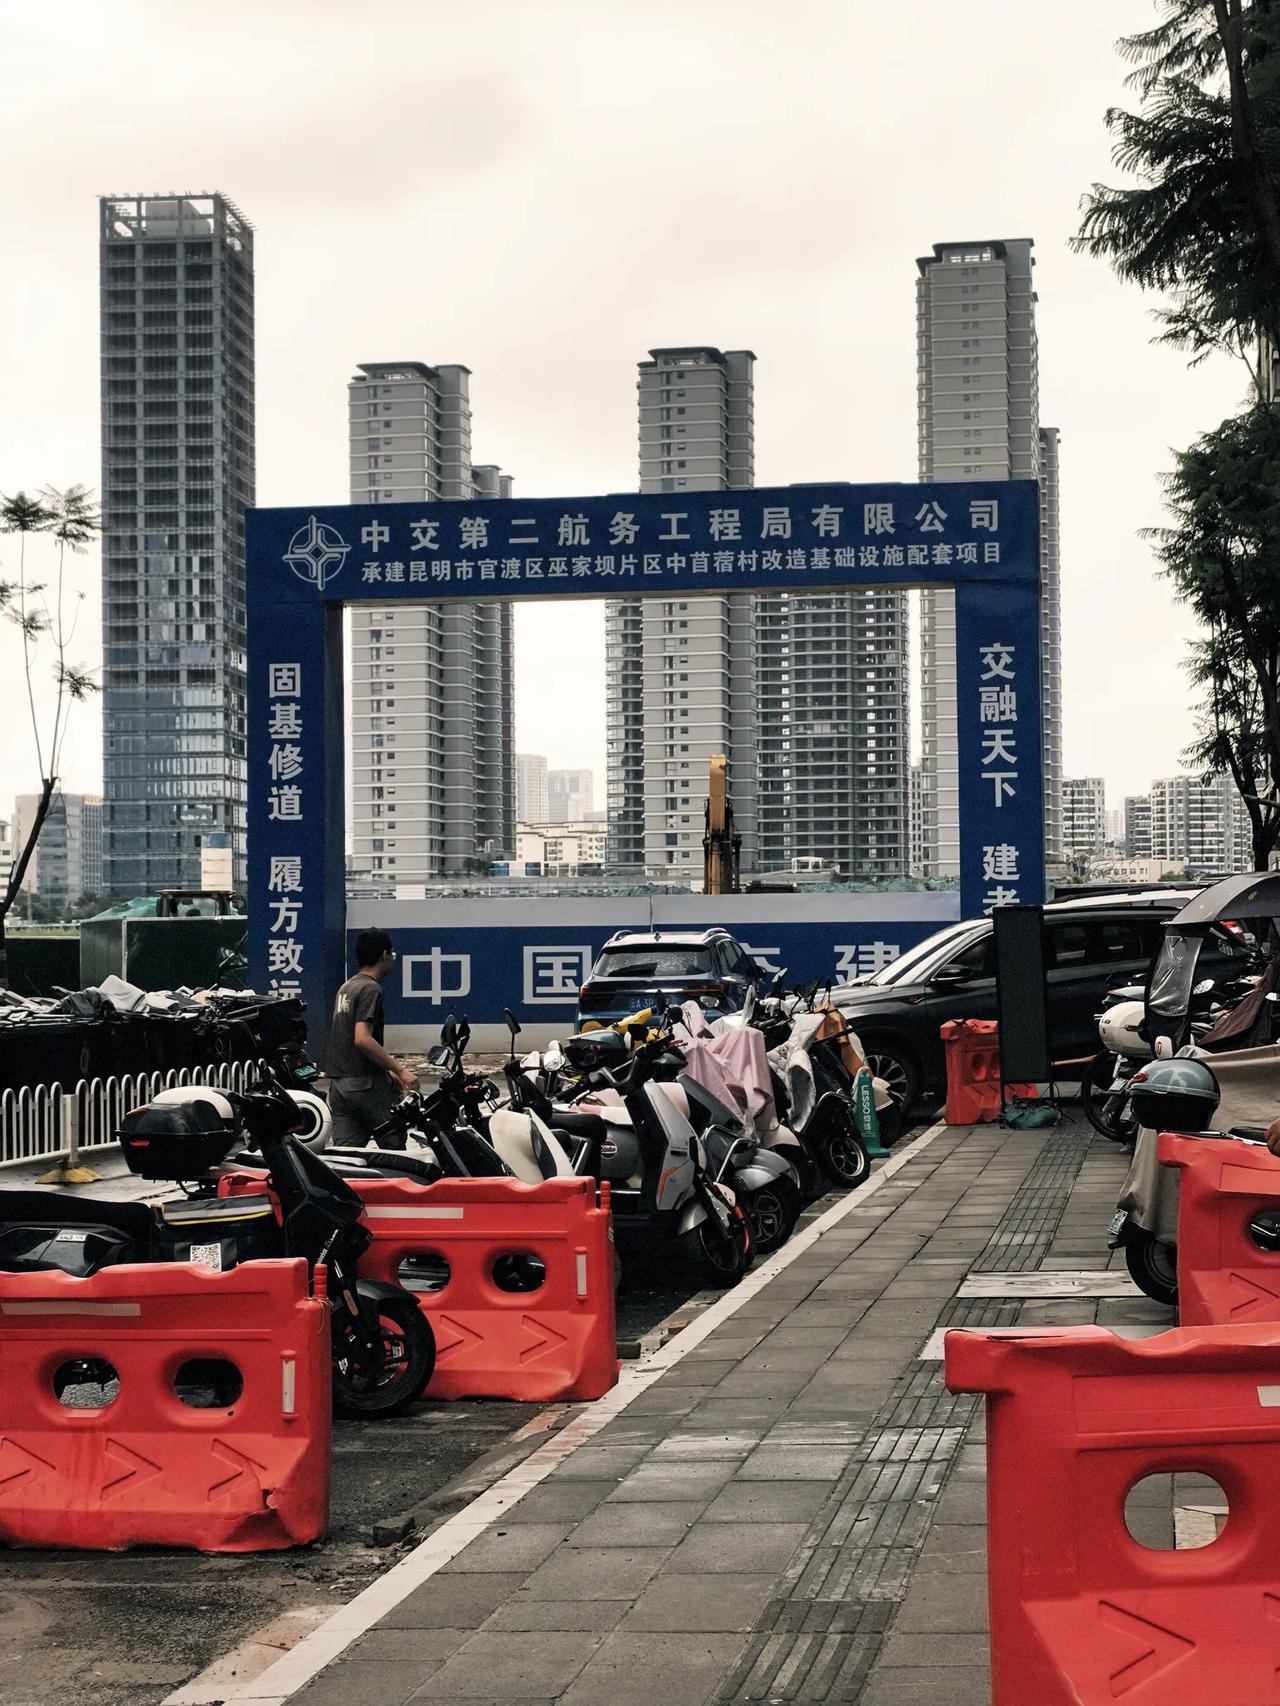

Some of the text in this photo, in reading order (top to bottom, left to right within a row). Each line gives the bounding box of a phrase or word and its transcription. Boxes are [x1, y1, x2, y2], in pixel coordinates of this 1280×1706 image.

[361, 500, 1000, 553] 中交第二航务工程局有限公司
[361, 542, 1001, 583] 承建昆明市官渡区巫家坝片区中苜蓿村改造基础设施配套项目
[268, 663, 303, 821] 固基修道
[979, 643, 1018, 807] 交融天下
[861, 1085, 870, 1115] LESSO
